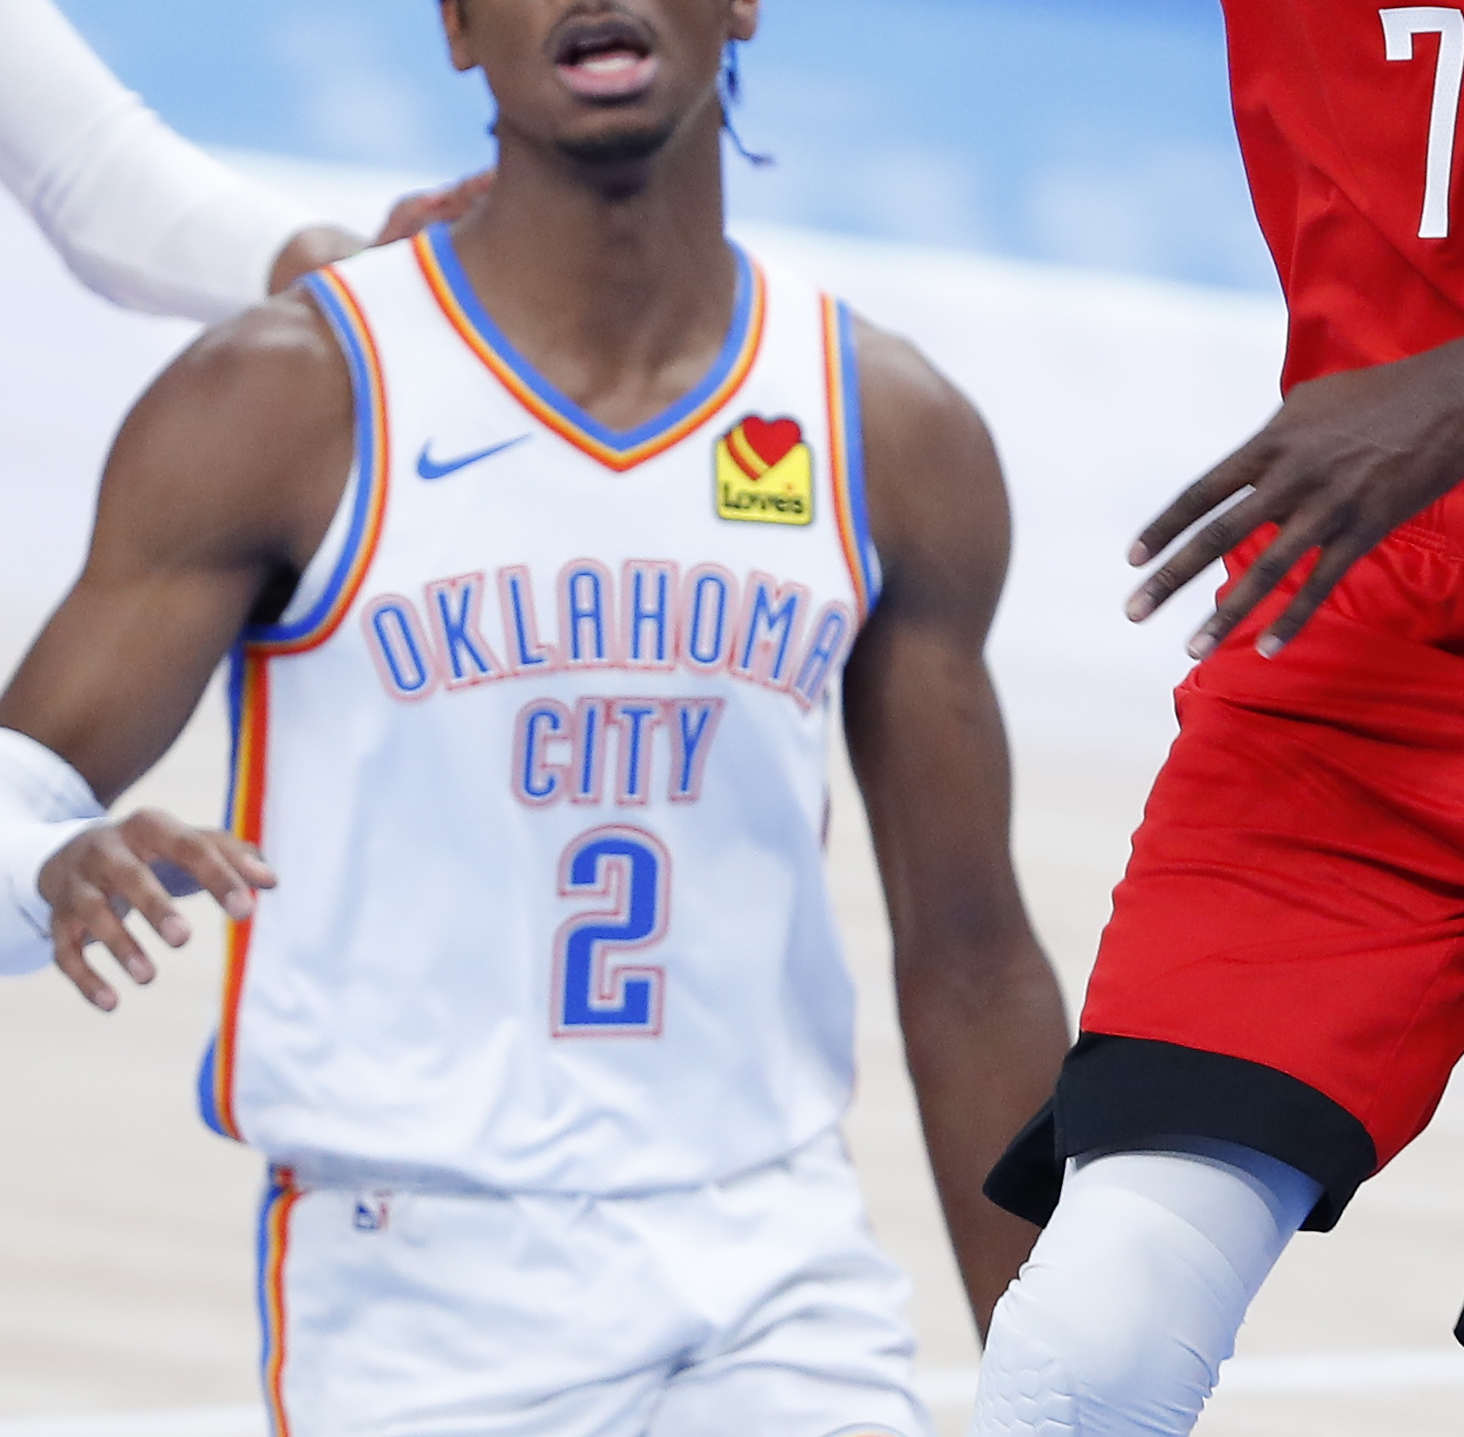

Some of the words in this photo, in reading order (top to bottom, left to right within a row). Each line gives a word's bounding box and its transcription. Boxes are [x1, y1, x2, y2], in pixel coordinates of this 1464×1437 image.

[362, 558, 856, 714] OKLAHOMA
[511, 696, 724, 805] CITY
[551, 824, 672, 1038] 2
